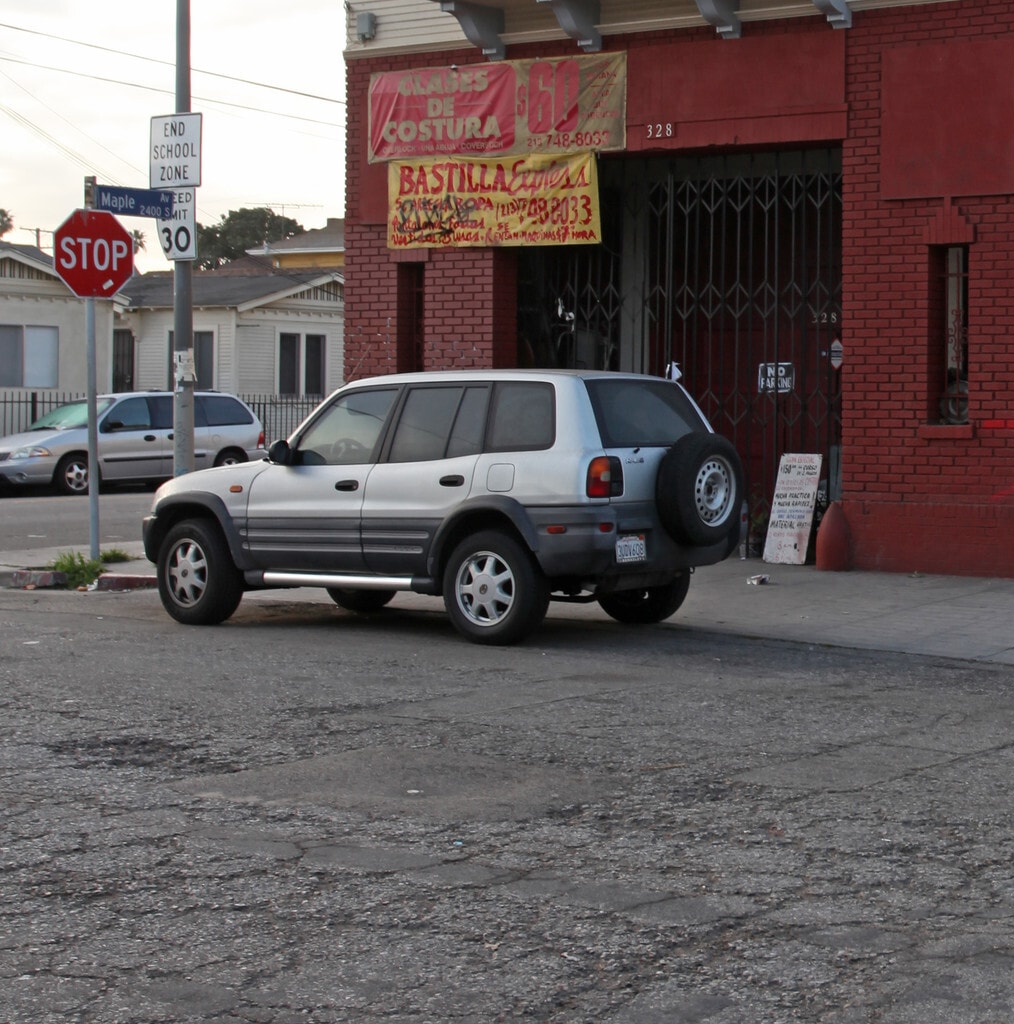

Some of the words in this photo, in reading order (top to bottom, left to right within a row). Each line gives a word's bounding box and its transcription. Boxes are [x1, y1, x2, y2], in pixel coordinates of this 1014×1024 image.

[398, 70, 489, 96] CLASES
[427, 97, 455, 117] DE
[163, 122, 186, 137] END
[382, 115, 502, 143] COSTURA
[647, 123, 673, 139] 328
[546, 131, 610, 148] 748-8033
[153, 142, 198, 160] SCHOOL
[160, 165, 190, 182] ZONE
[399, 162, 508, 196] BASTILLA
[101, 192, 136, 211] Maple
[160, 193, 170, 203] Av
[171, 192, 193, 205] EED
[139, 205, 162, 216] 2400
[164, 207, 171, 217] S
[161, 226, 191, 253] 30
[60, 236, 129, 272] STOP
[767, 366, 786, 377] NO
